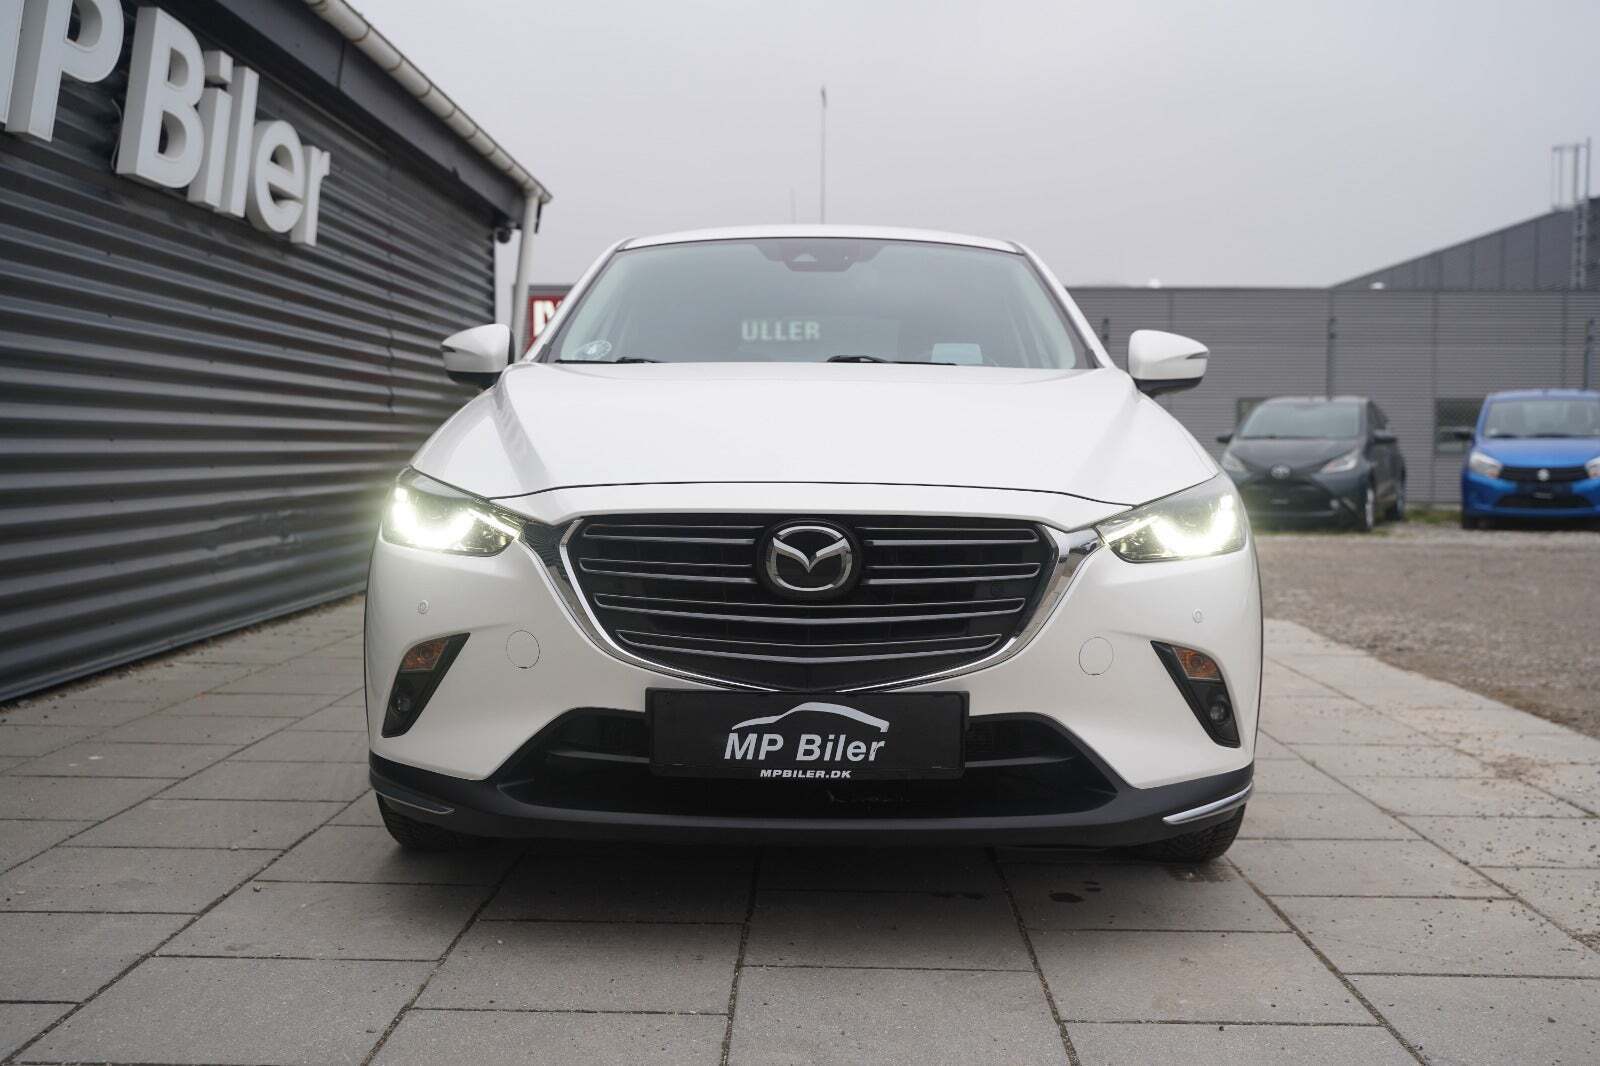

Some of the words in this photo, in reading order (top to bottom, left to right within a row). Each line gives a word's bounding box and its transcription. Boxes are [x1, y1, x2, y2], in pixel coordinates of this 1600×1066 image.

[0, 0, 124, 142] P
[116, 6, 331, 247] Biler
[740, 319, 821, 342] ULLER
[724, 732, 784, 761] MP
[795, 733, 886, 762] Biler
[759, 768, 852, 780] MPBILER.DK
